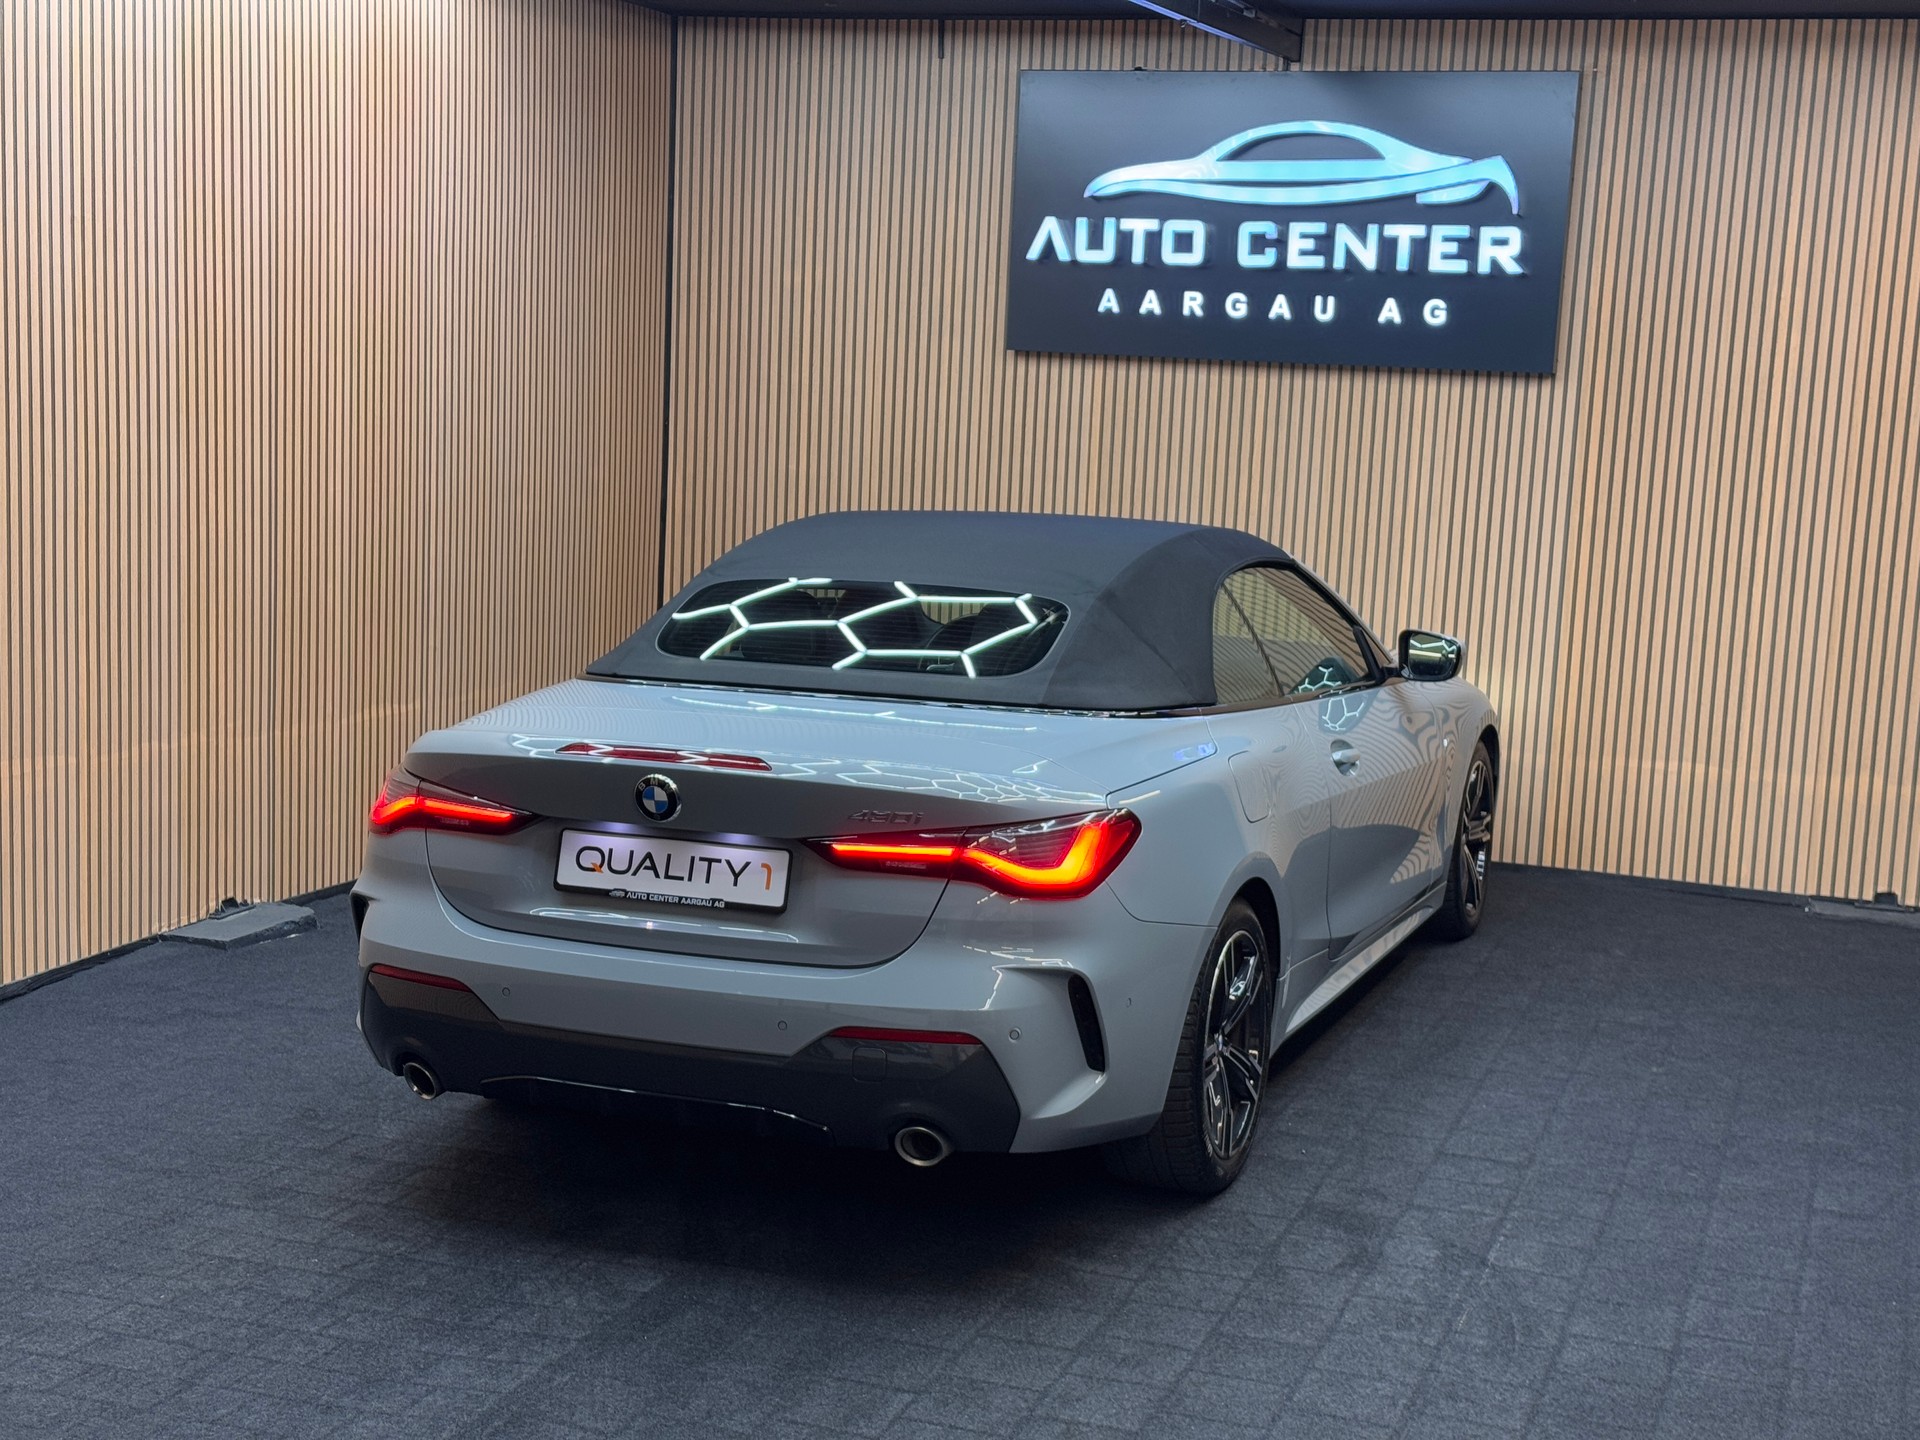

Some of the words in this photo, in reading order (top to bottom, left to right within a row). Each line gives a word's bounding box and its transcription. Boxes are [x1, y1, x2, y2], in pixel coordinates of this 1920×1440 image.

[1025, 215, 1207, 267] AUTO
[1236, 220, 1526, 275] CENTER
[1097, 287, 1336, 323] AARGAU
[1377, 297, 1449, 327] AG
[575, 845, 752, 888] QUALITY
[760, 862, 773, 891] 1
[626, 890, 648, 900] AUTO
[649, 894, 679, 904] CENTER
[680, 897, 712, 907] AARGAU
[713, 900, 726, 909] AG
